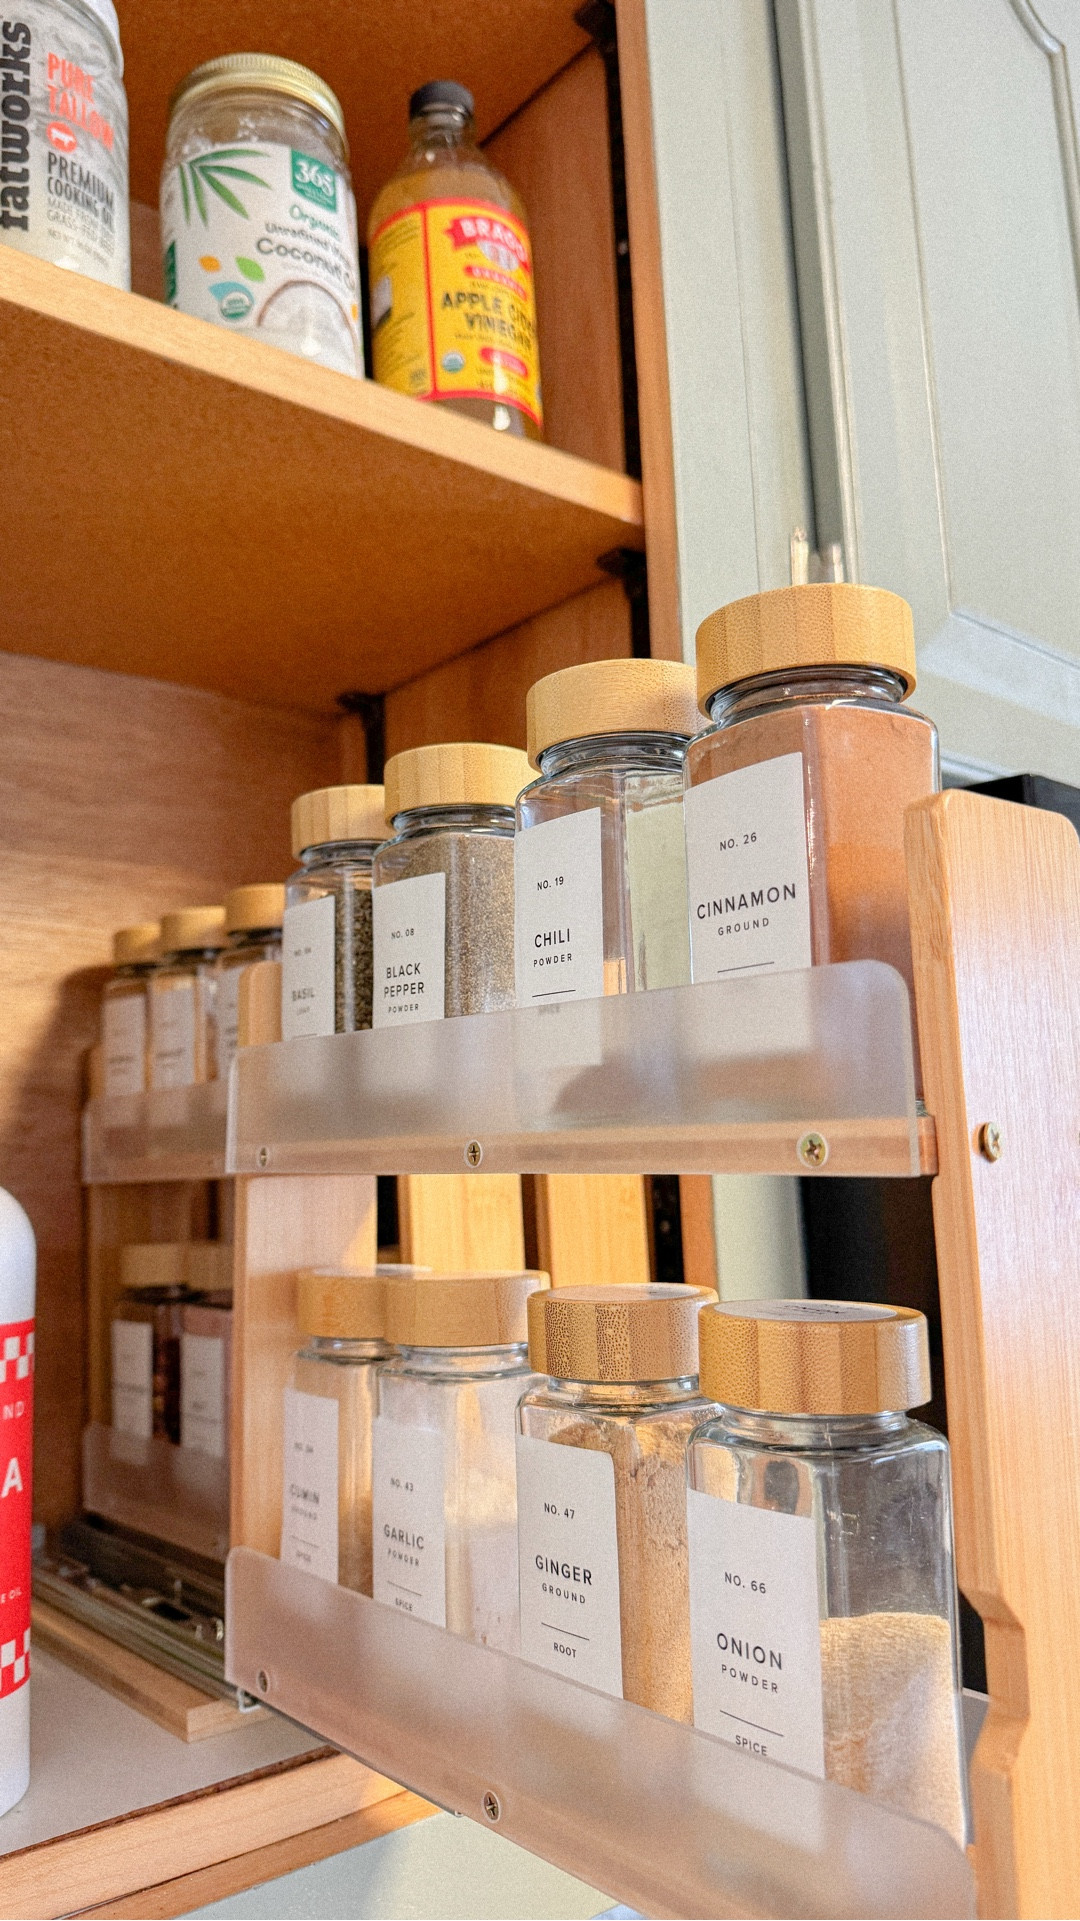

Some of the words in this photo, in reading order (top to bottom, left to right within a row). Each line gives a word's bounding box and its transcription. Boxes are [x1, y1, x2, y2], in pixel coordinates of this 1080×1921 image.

[0, 21, 31, 232] fatworks
[47, 151, 114, 212] PREMIUM
[294, 160, 334, 198] 365
[47, 176, 99, 218] COOKING
[256, 237, 341, 280] Coconut
[441, 290, 502, 313] APPLE
[720, 838, 739, 851] NO.
[743, 832, 758, 845] 26
[537, 879, 551, 891] NO.
[555, 876, 564, 886] 19
[697, 883, 797, 919] CINNAMON
[391, 930, 403, 939] NO.
[718, 917, 769, 936] GROUND
[534, 928, 571, 948] CHILI
[533, 953, 572, 967] POWDER
[387, 963, 421, 979] BLACK
[384, 982, 424, 998] PEPPER
[388, 1003, 419, 1013] POWDER
[289, 1484, 319, 1504] CUMIN
[390, 1477, 402, 1489] NO.
[405, 1481, 414, 1492] 43
[544, 1502, 560, 1516] NO.
[564, 1508, 575, 1519] 47
[384, 1524, 424, 1550] GARLIC
[387, 1548, 420, 1567] POWDER
[535, 1554, 593, 1586] GINGER
[542, 1582, 586, 1604] GROUND
[724, 1572, 746, 1589] NO.
[750, 1580, 767, 1594] 66
[395, 1598, 413, 1612] SPICE
[553, 1642, 577, 1658] ROOT
[716, 1632, 783, 1671] ONION
[721, 1663, 778, 1693] POWDER
[735, 1734, 768, 1757] SPICE
